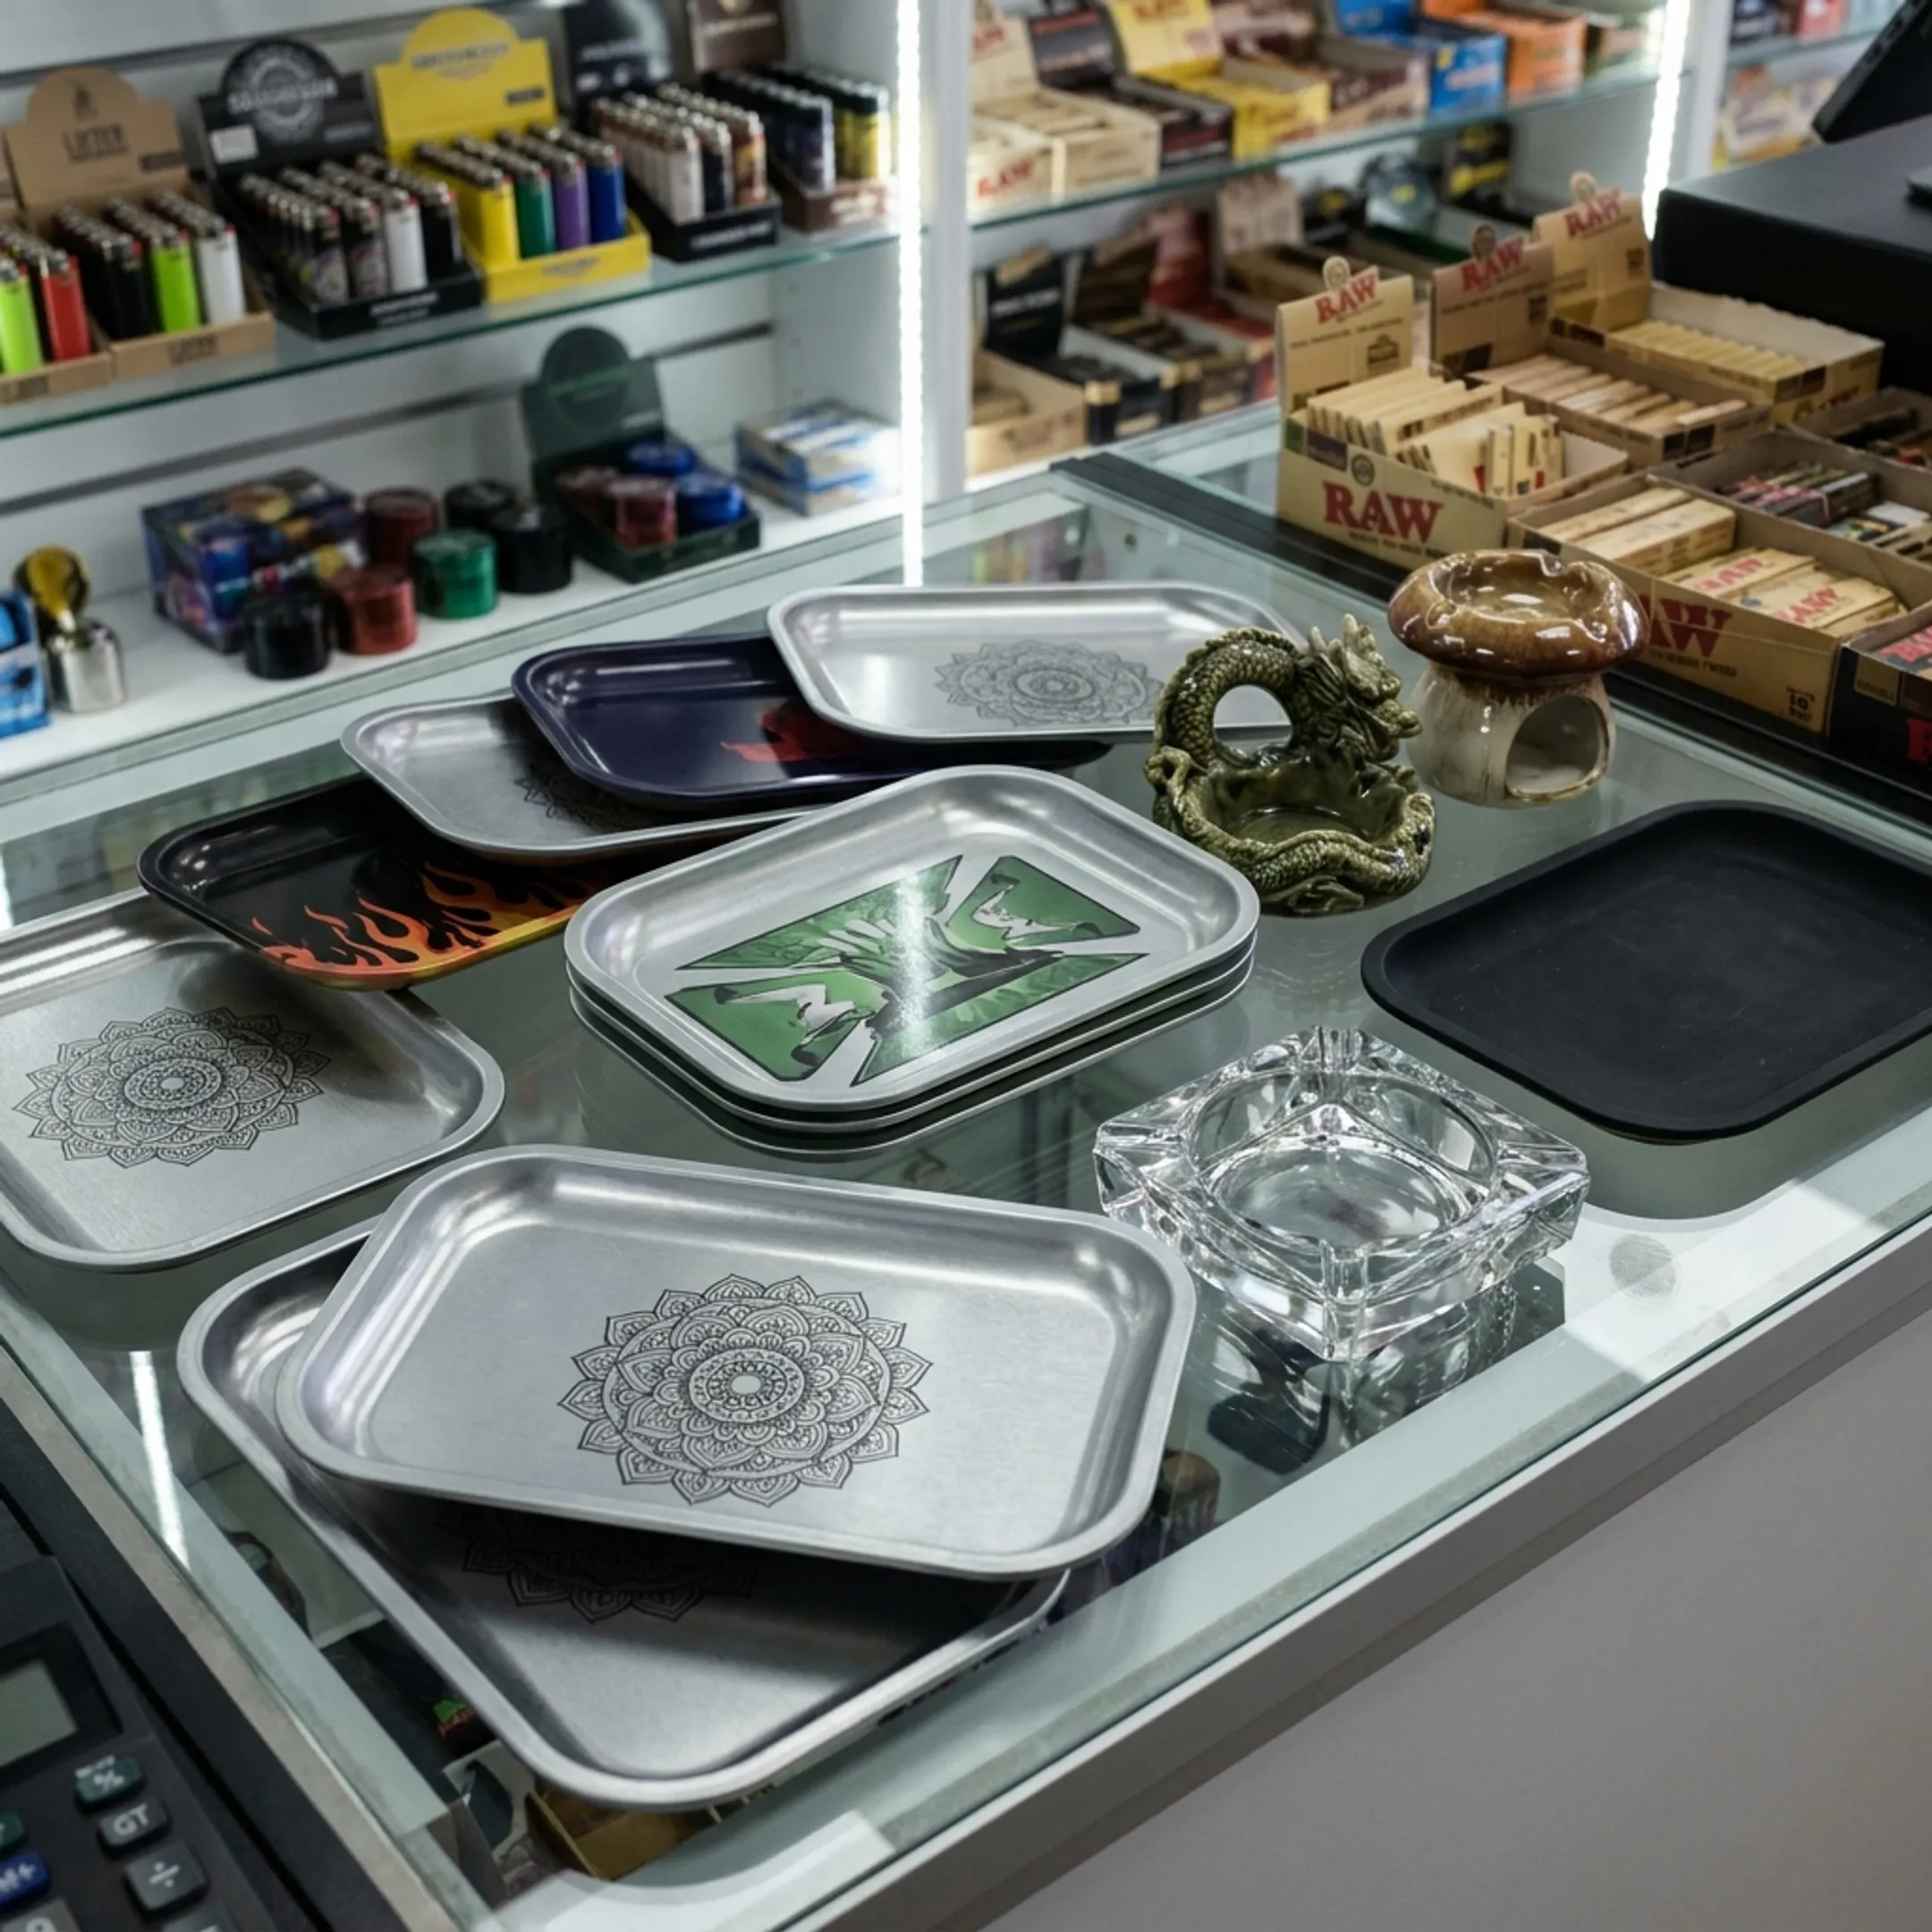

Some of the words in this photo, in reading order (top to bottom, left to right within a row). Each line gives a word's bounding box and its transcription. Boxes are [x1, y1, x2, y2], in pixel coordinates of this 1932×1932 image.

[1563, 186, 1621, 239] RAW
[1461, 235, 1524, 292] RAW
[1313, 272, 1377, 326] RAW
[1322, 480, 1444, 545] RAW
[113, 1803, 148, 1835] GT
